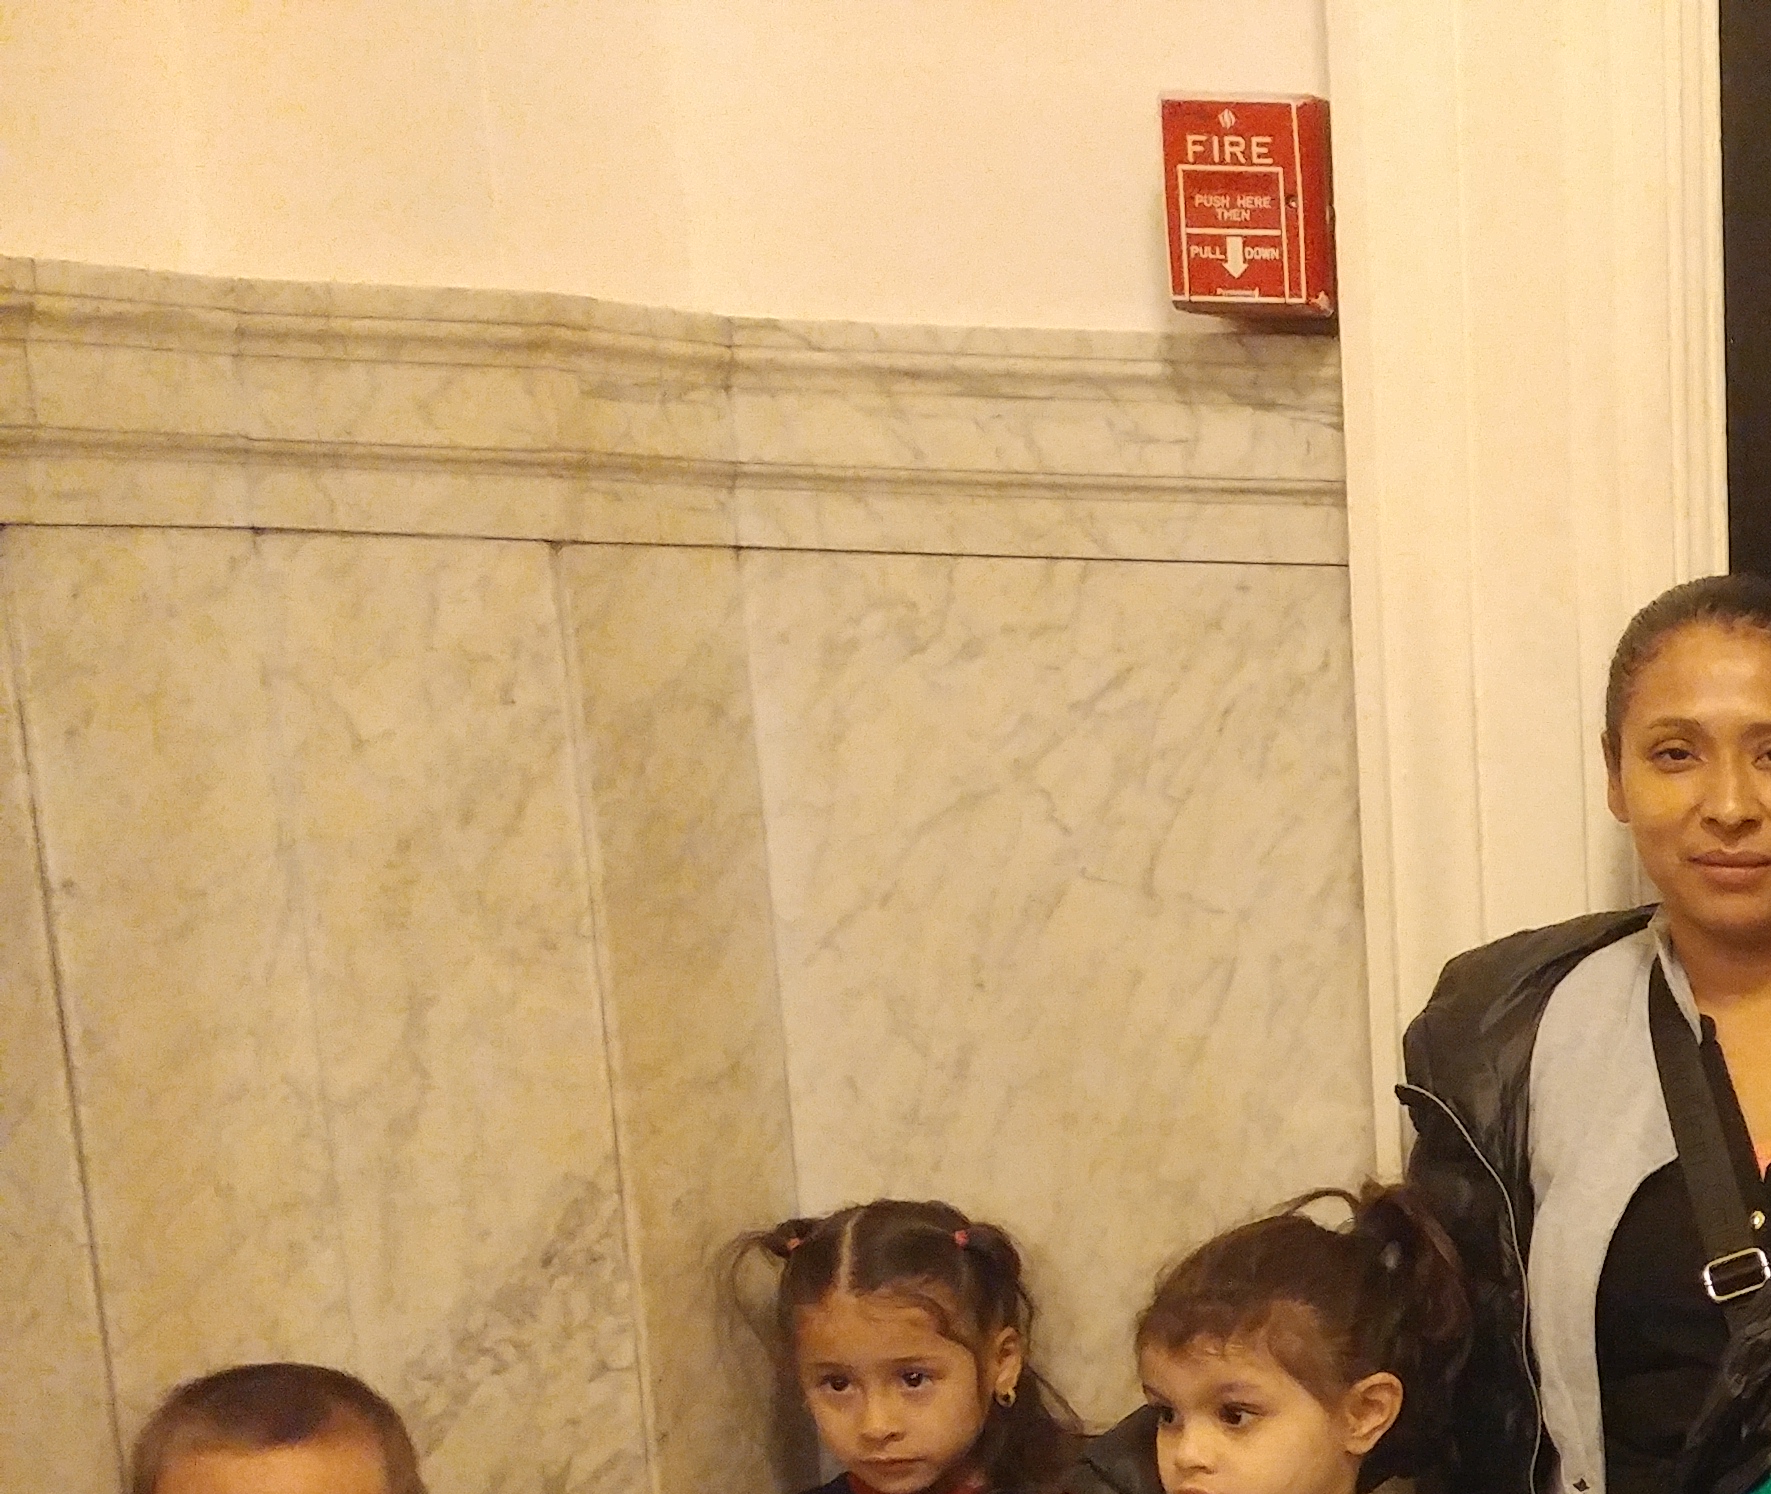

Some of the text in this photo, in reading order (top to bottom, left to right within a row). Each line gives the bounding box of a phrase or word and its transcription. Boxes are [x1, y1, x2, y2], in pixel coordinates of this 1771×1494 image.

[1186, 134, 1273, 164] FIRE
[1194, 194, 1271, 208] PUSH HERE
[1216, 209, 1250, 221] THEN
[1190, 246, 1280, 260] PULL DOWN
